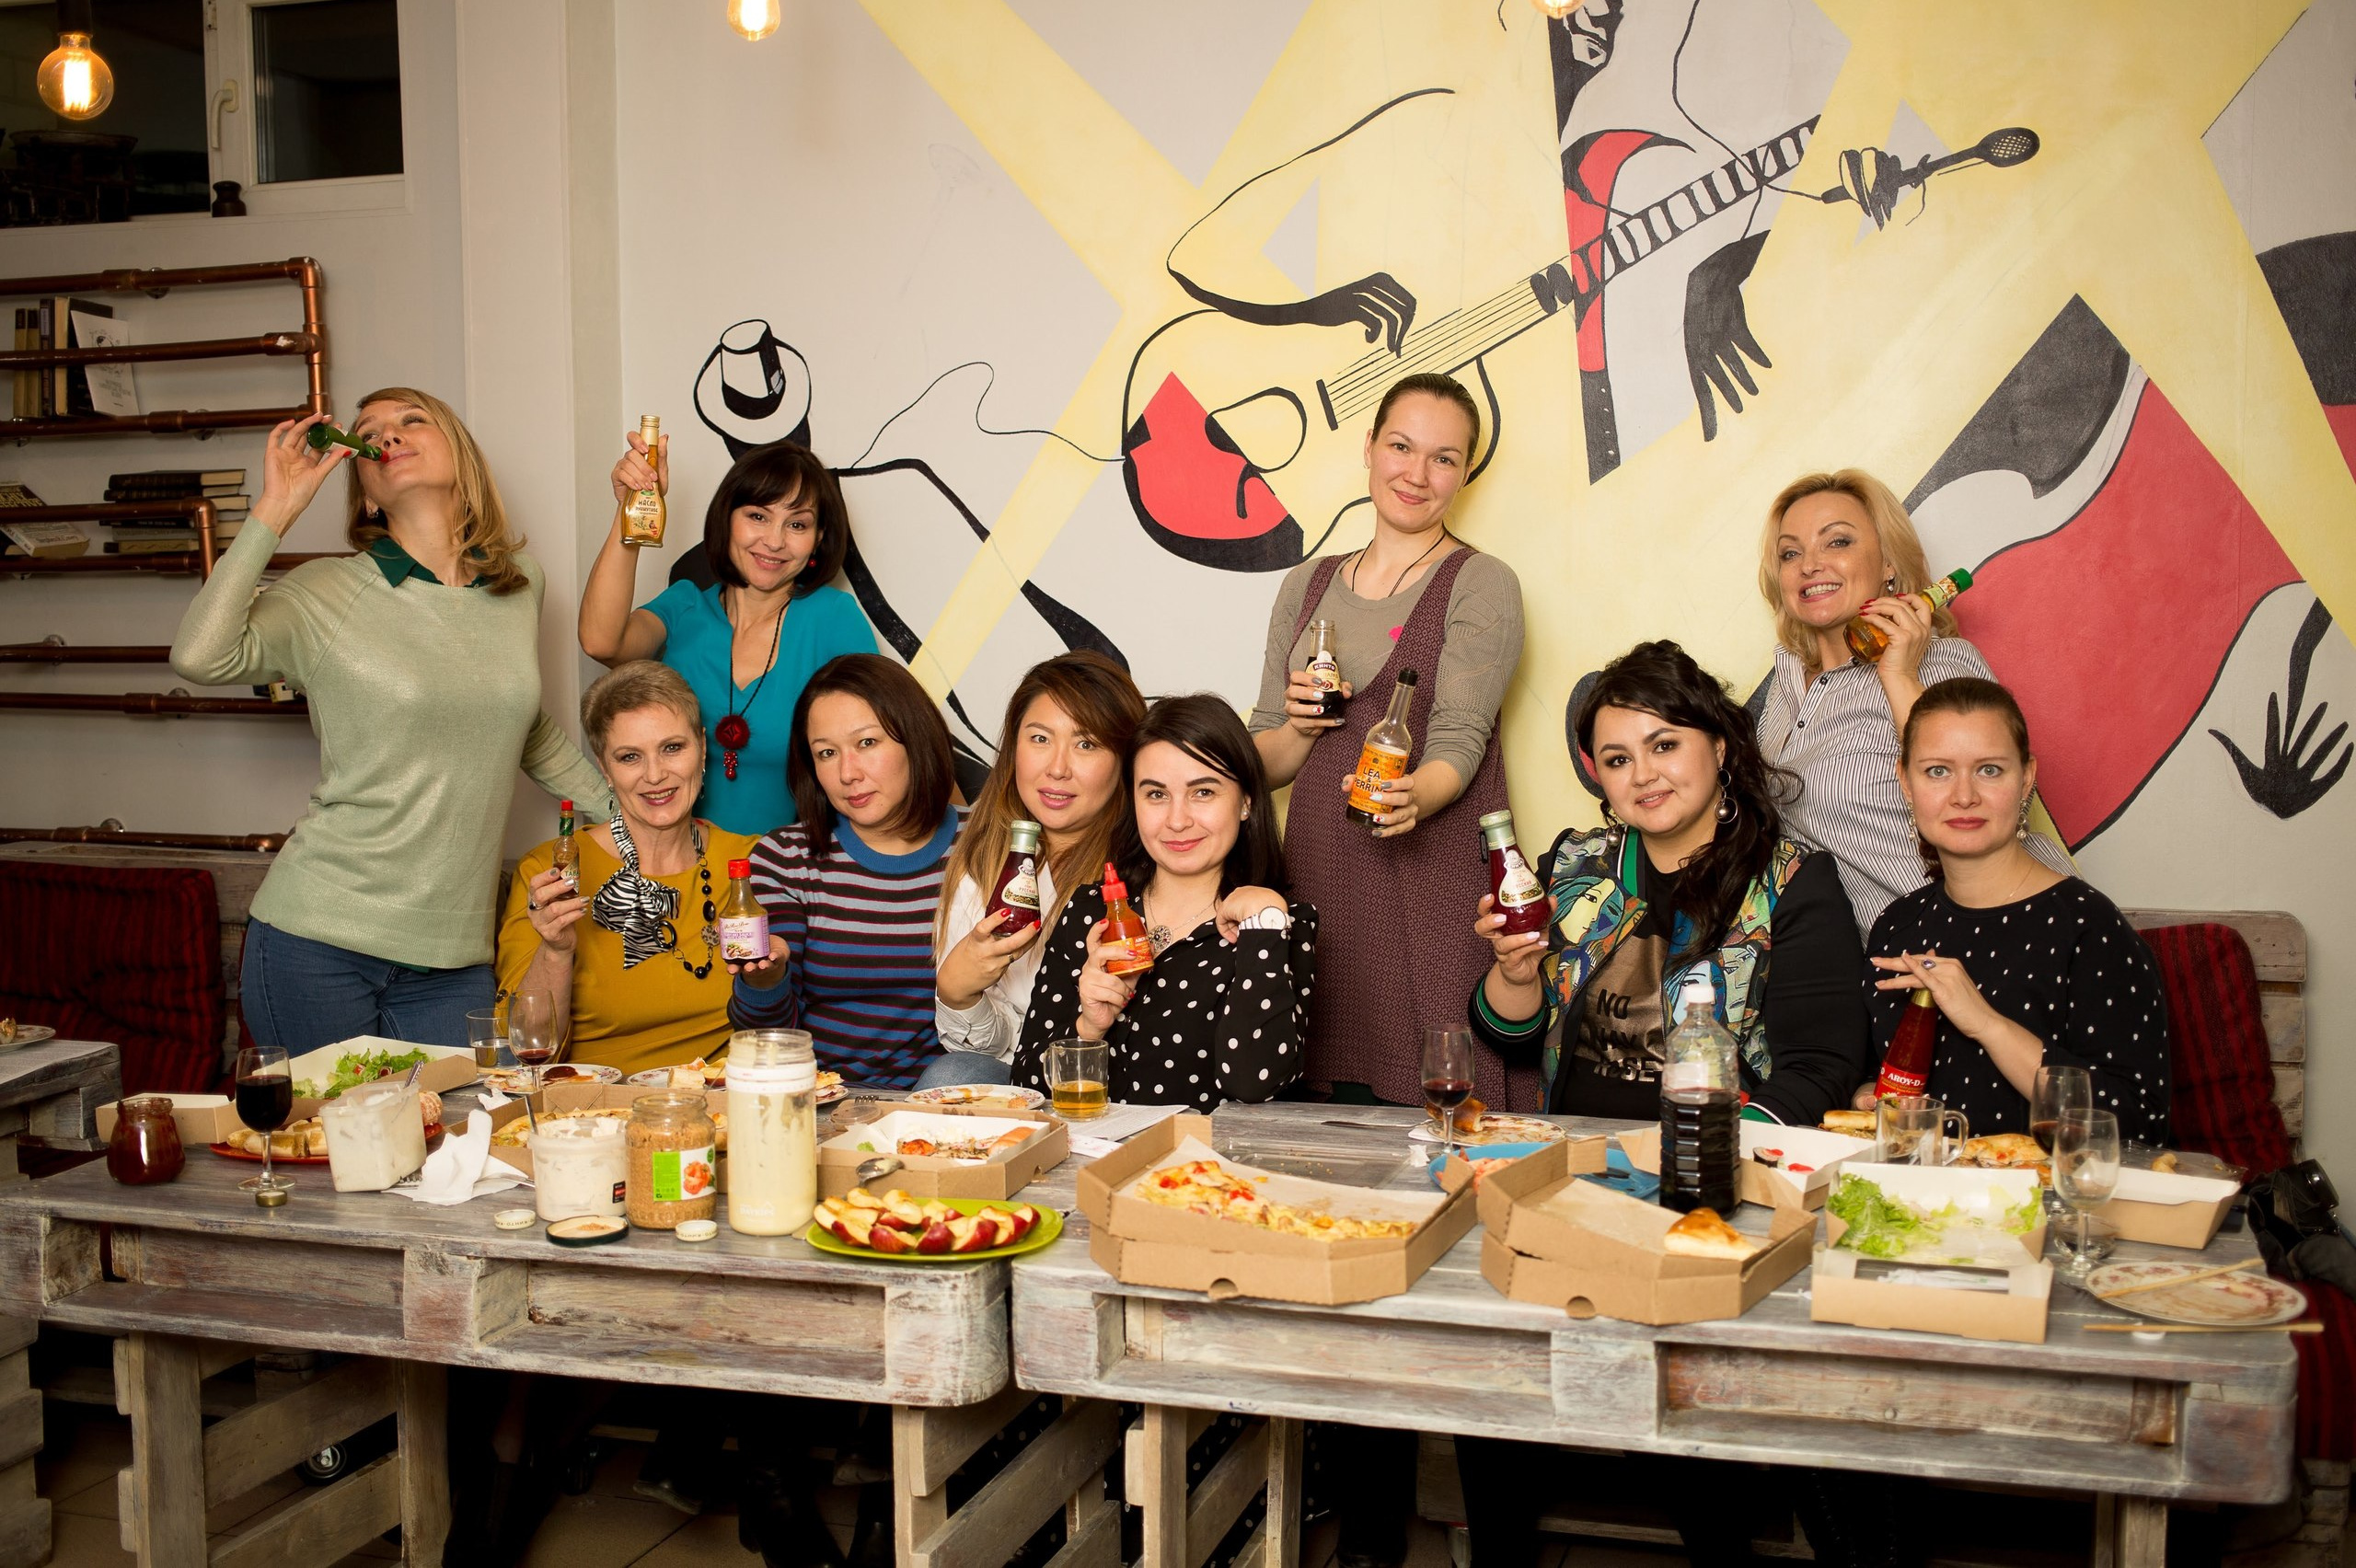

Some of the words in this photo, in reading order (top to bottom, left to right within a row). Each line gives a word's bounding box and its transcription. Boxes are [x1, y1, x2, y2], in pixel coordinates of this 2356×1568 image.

[1363, 766, 1380, 779] LEA
[1355, 777, 1383, 792] ERRIN
[1597, 988, 1631, 1020] NO
[1888, 1073, 1921, 1087] AROY-D
